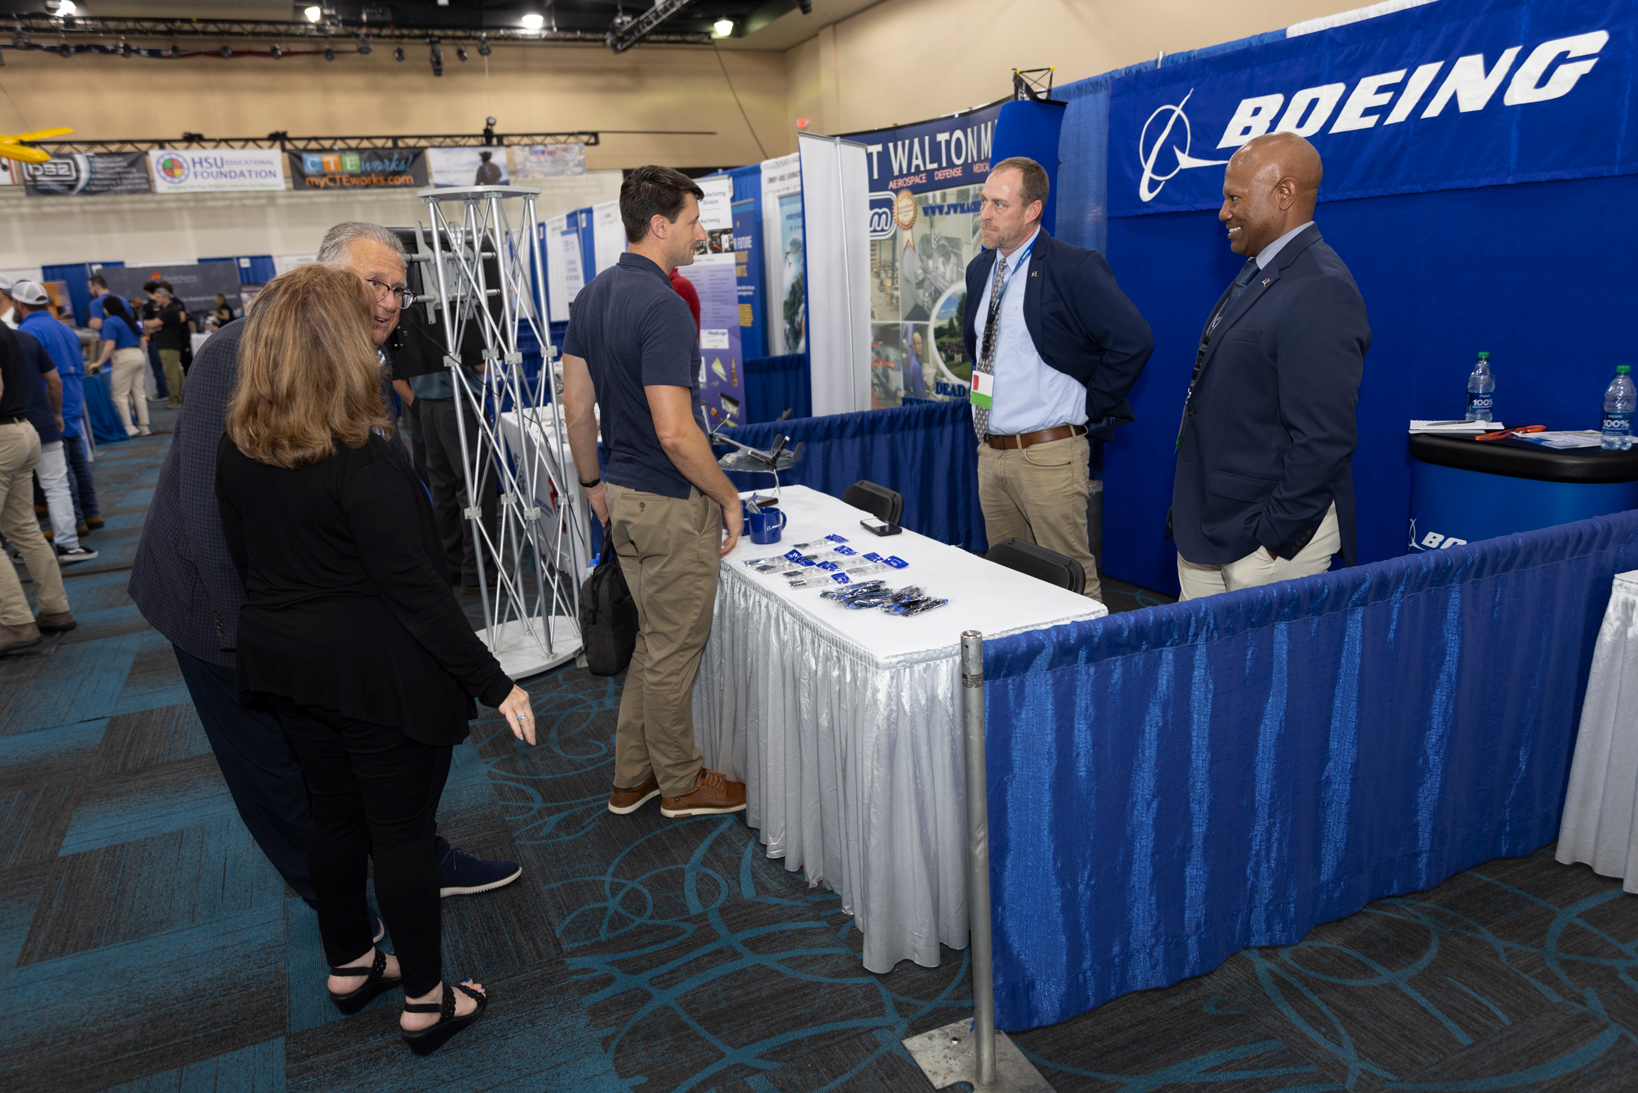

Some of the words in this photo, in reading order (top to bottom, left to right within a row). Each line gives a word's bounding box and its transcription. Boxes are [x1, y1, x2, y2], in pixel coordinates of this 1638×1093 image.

[1216, 30, 1609, 149] BOEING
[887, 126, 978, 177] WALTON
[191, 156, 225, 170] HSU
[193, 168, 278, 180] FOUNDATION
[304, 173, 415, 189] myCTEworks.com
[888, 172, 927, 190] AEROSPACE
[934, 166, 963, 180] DEFENSE
[935, 381, 967, 398] DEAD
[1603, 419, 1630, 428] 100%
